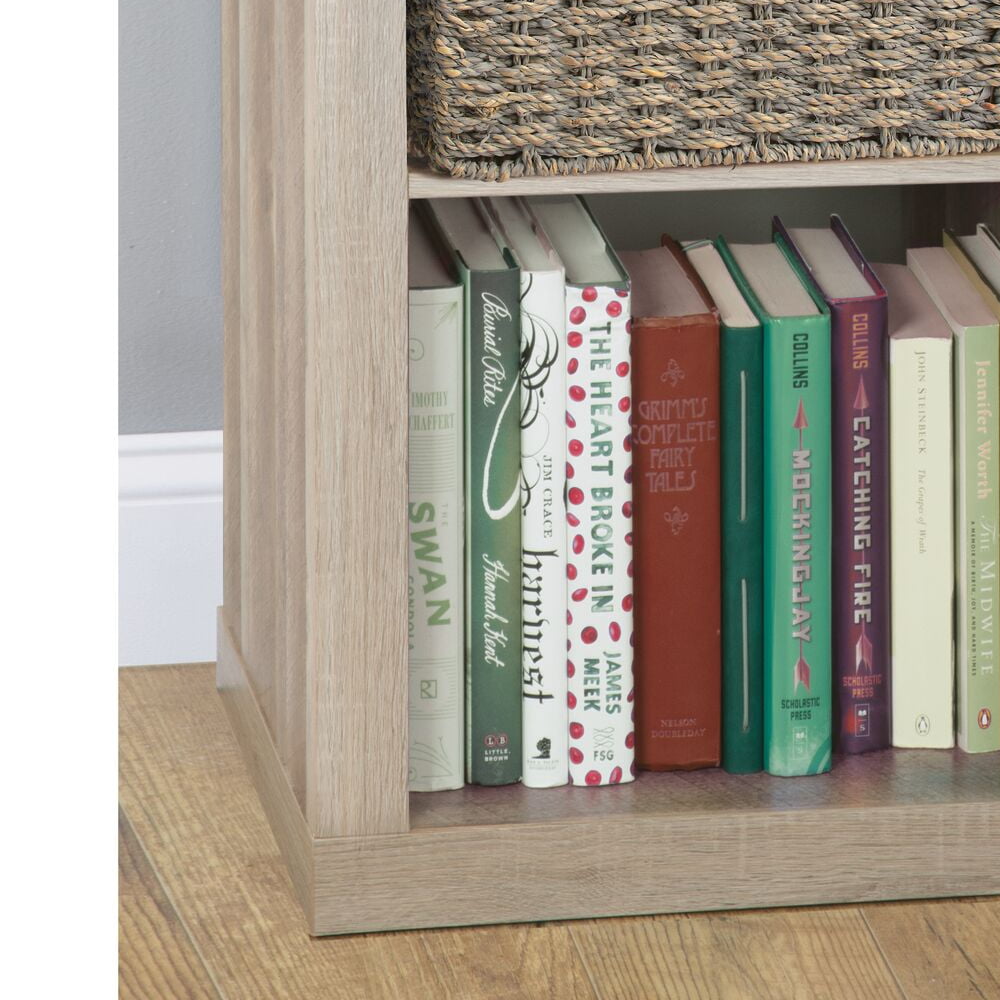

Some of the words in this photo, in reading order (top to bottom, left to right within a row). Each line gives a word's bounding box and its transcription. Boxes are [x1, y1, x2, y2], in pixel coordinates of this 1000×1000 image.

[482, 291, 512, 357] Burial
[589, 321, 612, 371] THE
[852, 312, 868, 369] COLLINS
[482, 355, 506, 407] Rites
[793, 333, 808, 389] COLLINS
[914, 351, 927, 383] JOHN
[411, 391, 448, 409] IMOTHY
[638, 397, 708, 421] GRIMM'S
[917, 387, 928, 455] STEINBECK
[975, 360, 993, 434] Jennifer
[590, 381, 613, 476] HEART
[543, 454, 552, 482] JIM
[645, 470, 696, 493] TALES
[649, 446, 696, 468] FAIRY
[976, 440, 993, 500] Worth
[853, 416, 871, 551] CATCHING
[441, 503, 449, 527] THE
[543, 489, 552, 538] CRACE
[591, 487, 613, 575] BROKE
[408, 501, 452, 626] SWAN
[792, 450, 811, 642] MOCKINGJAY
[970, 559, 977, 568] OF
[483, 553, 510, 624] Hannah
[591, 585, 614, 613] IN
[853, 563, 871, 624] FIRE
[980, 560, 996, 676] MIDWIFE
[484, 621, 509, 667] Kent
[584, 658, 601, 711] MEEK
[603, 652, 622, 714] JAMES
[781, 697, 820, 709] SCHOLASTIC
[842, 673, 882, 687] SCHOLASTIC
[852, 687, 874, 698] PRESS
[651, 728, 706, 738] DOUBLEDAY
[660, 718, 697, 727] NELSON
[790, 710, 812, 720] PRESS
[593, 750, 614, 761] FSG
